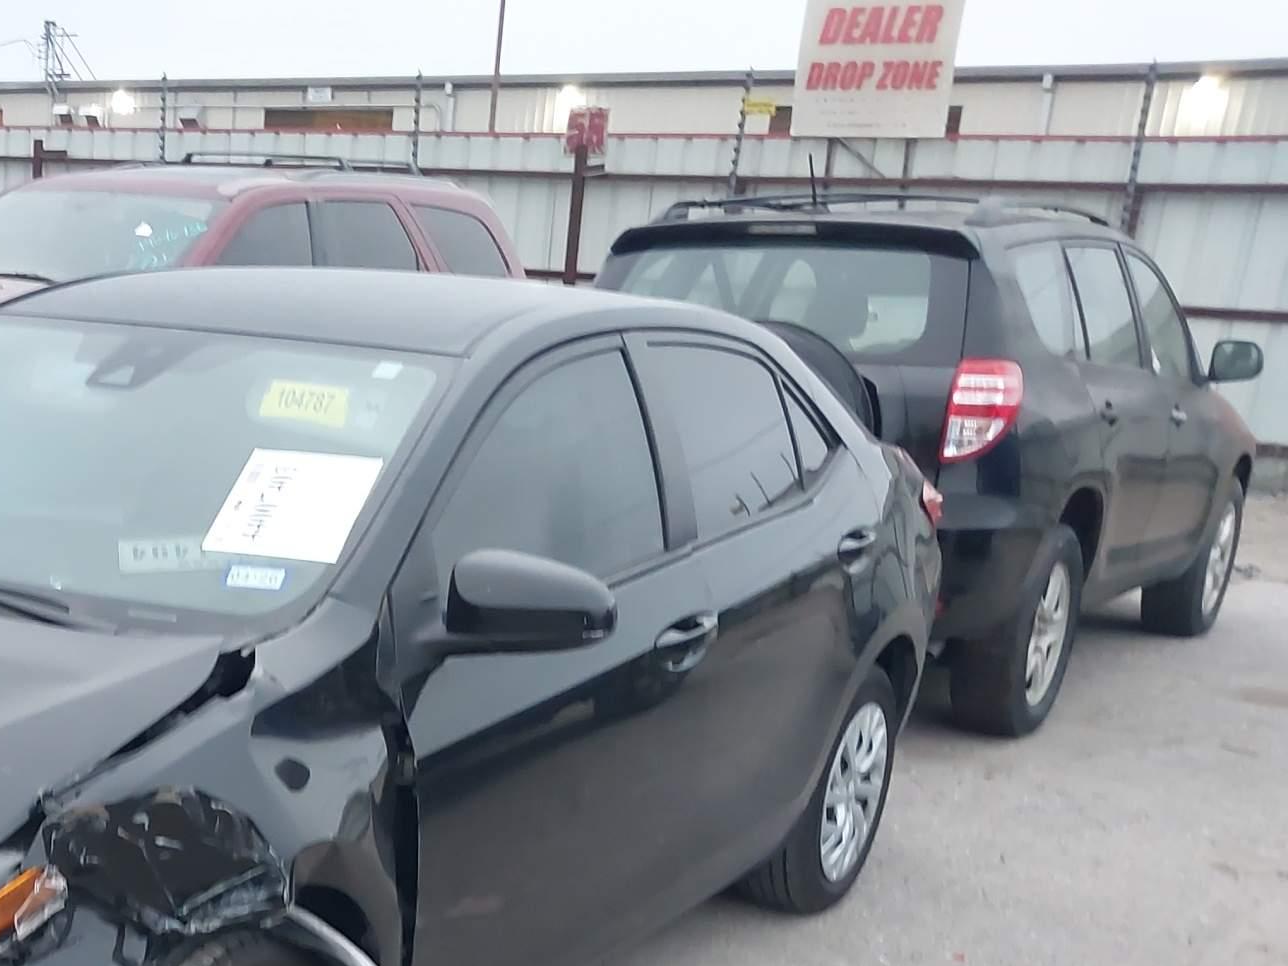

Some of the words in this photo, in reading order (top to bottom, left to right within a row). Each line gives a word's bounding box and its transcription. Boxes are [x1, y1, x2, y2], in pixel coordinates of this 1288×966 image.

[818, 4, 944, 46] DEALER
[805, 60, 876, 91] DROP
[875, 59, 944, 91] ZONE
[277, 387, 337, 415] 104787
